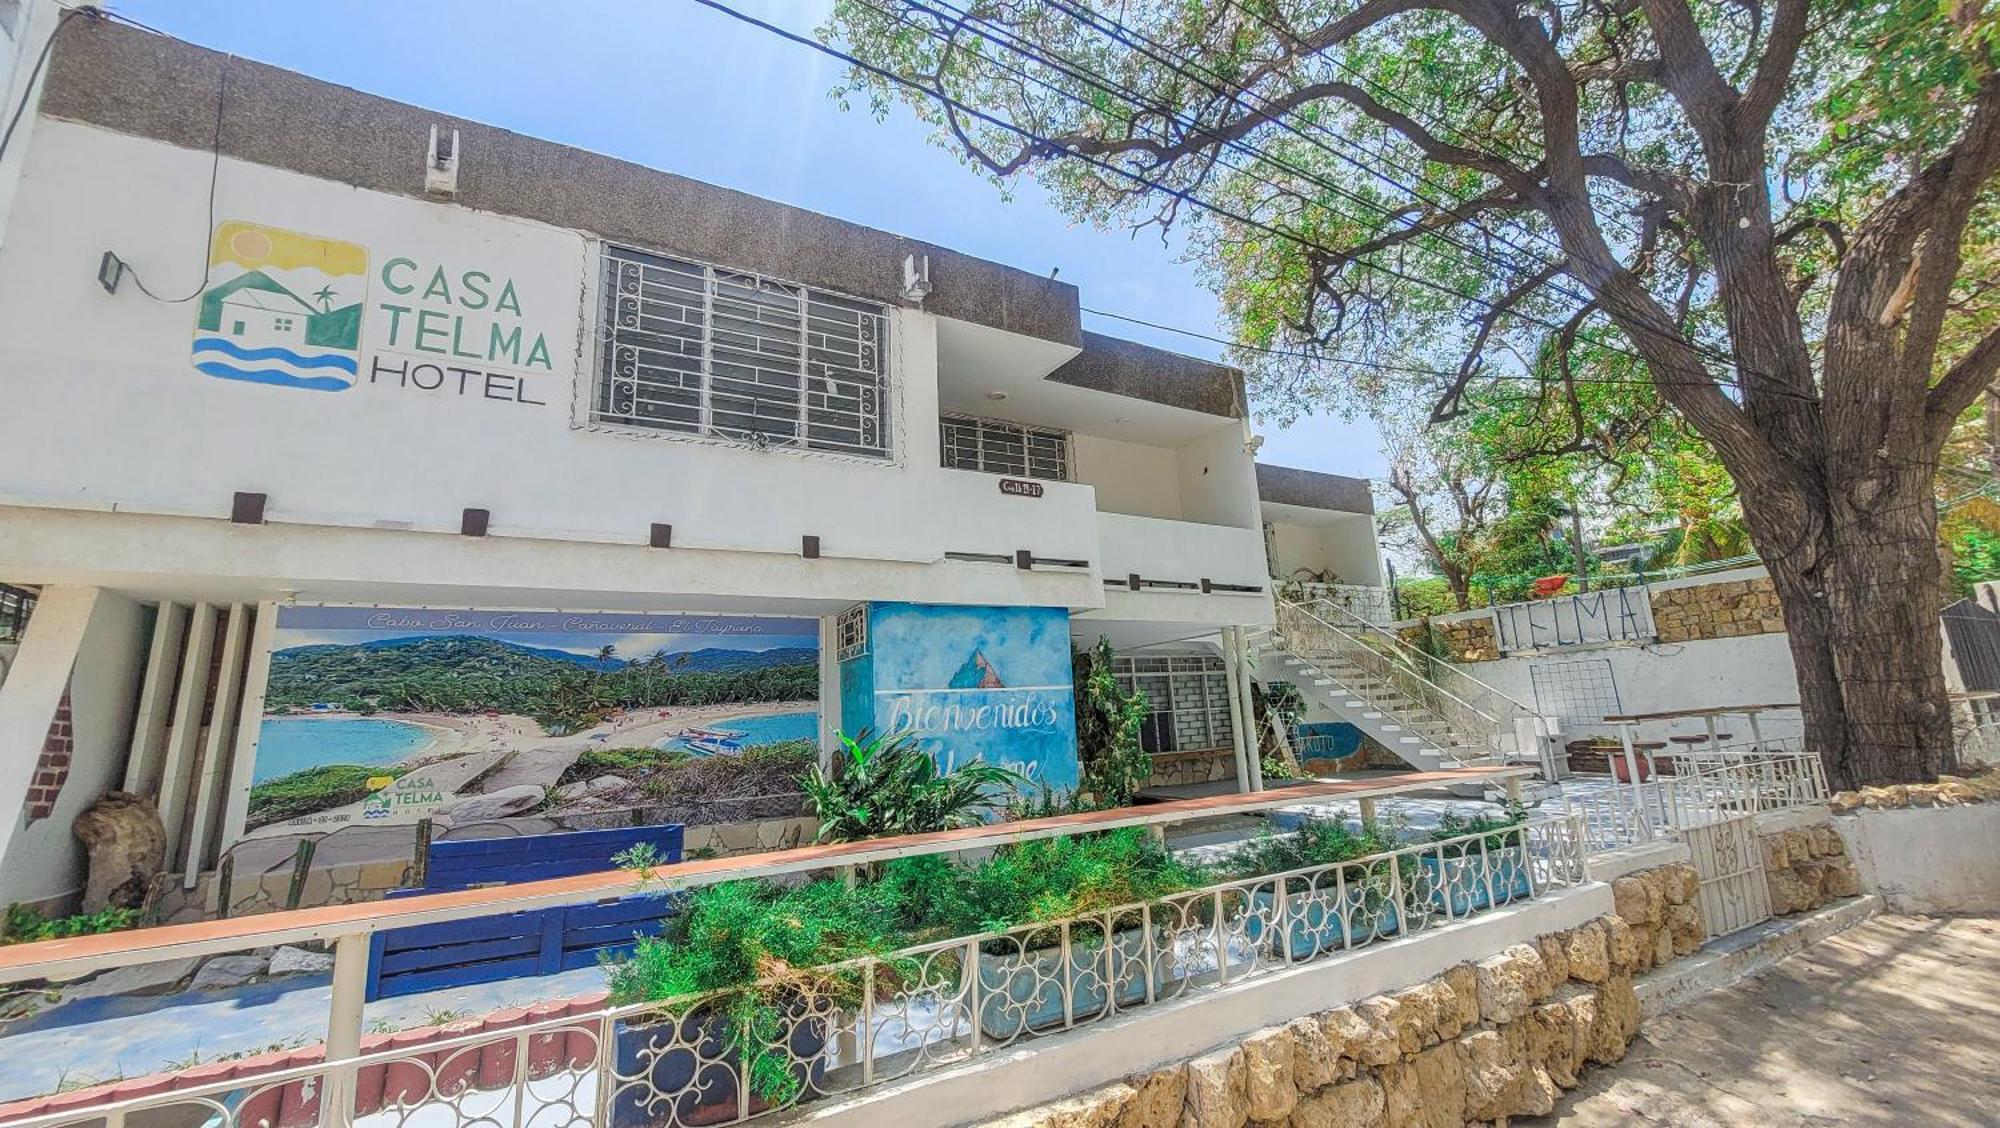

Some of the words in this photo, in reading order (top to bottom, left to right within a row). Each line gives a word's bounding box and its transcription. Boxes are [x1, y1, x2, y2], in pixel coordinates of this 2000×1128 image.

[382, 257, 522, 317] CASA
[380, 303, 552, 370] TELMA
[370, 355, 546, 406] HOTEL
[367, 612, 422, 629] Cabo
[430, 614, 481, 630] San
[489, 614, 545, 632] Juan
[887, 692, 1057, 734] Bienvenidos
[396, 790, 443, 804] TELMA
[397, 778, 434, 789] CASA
